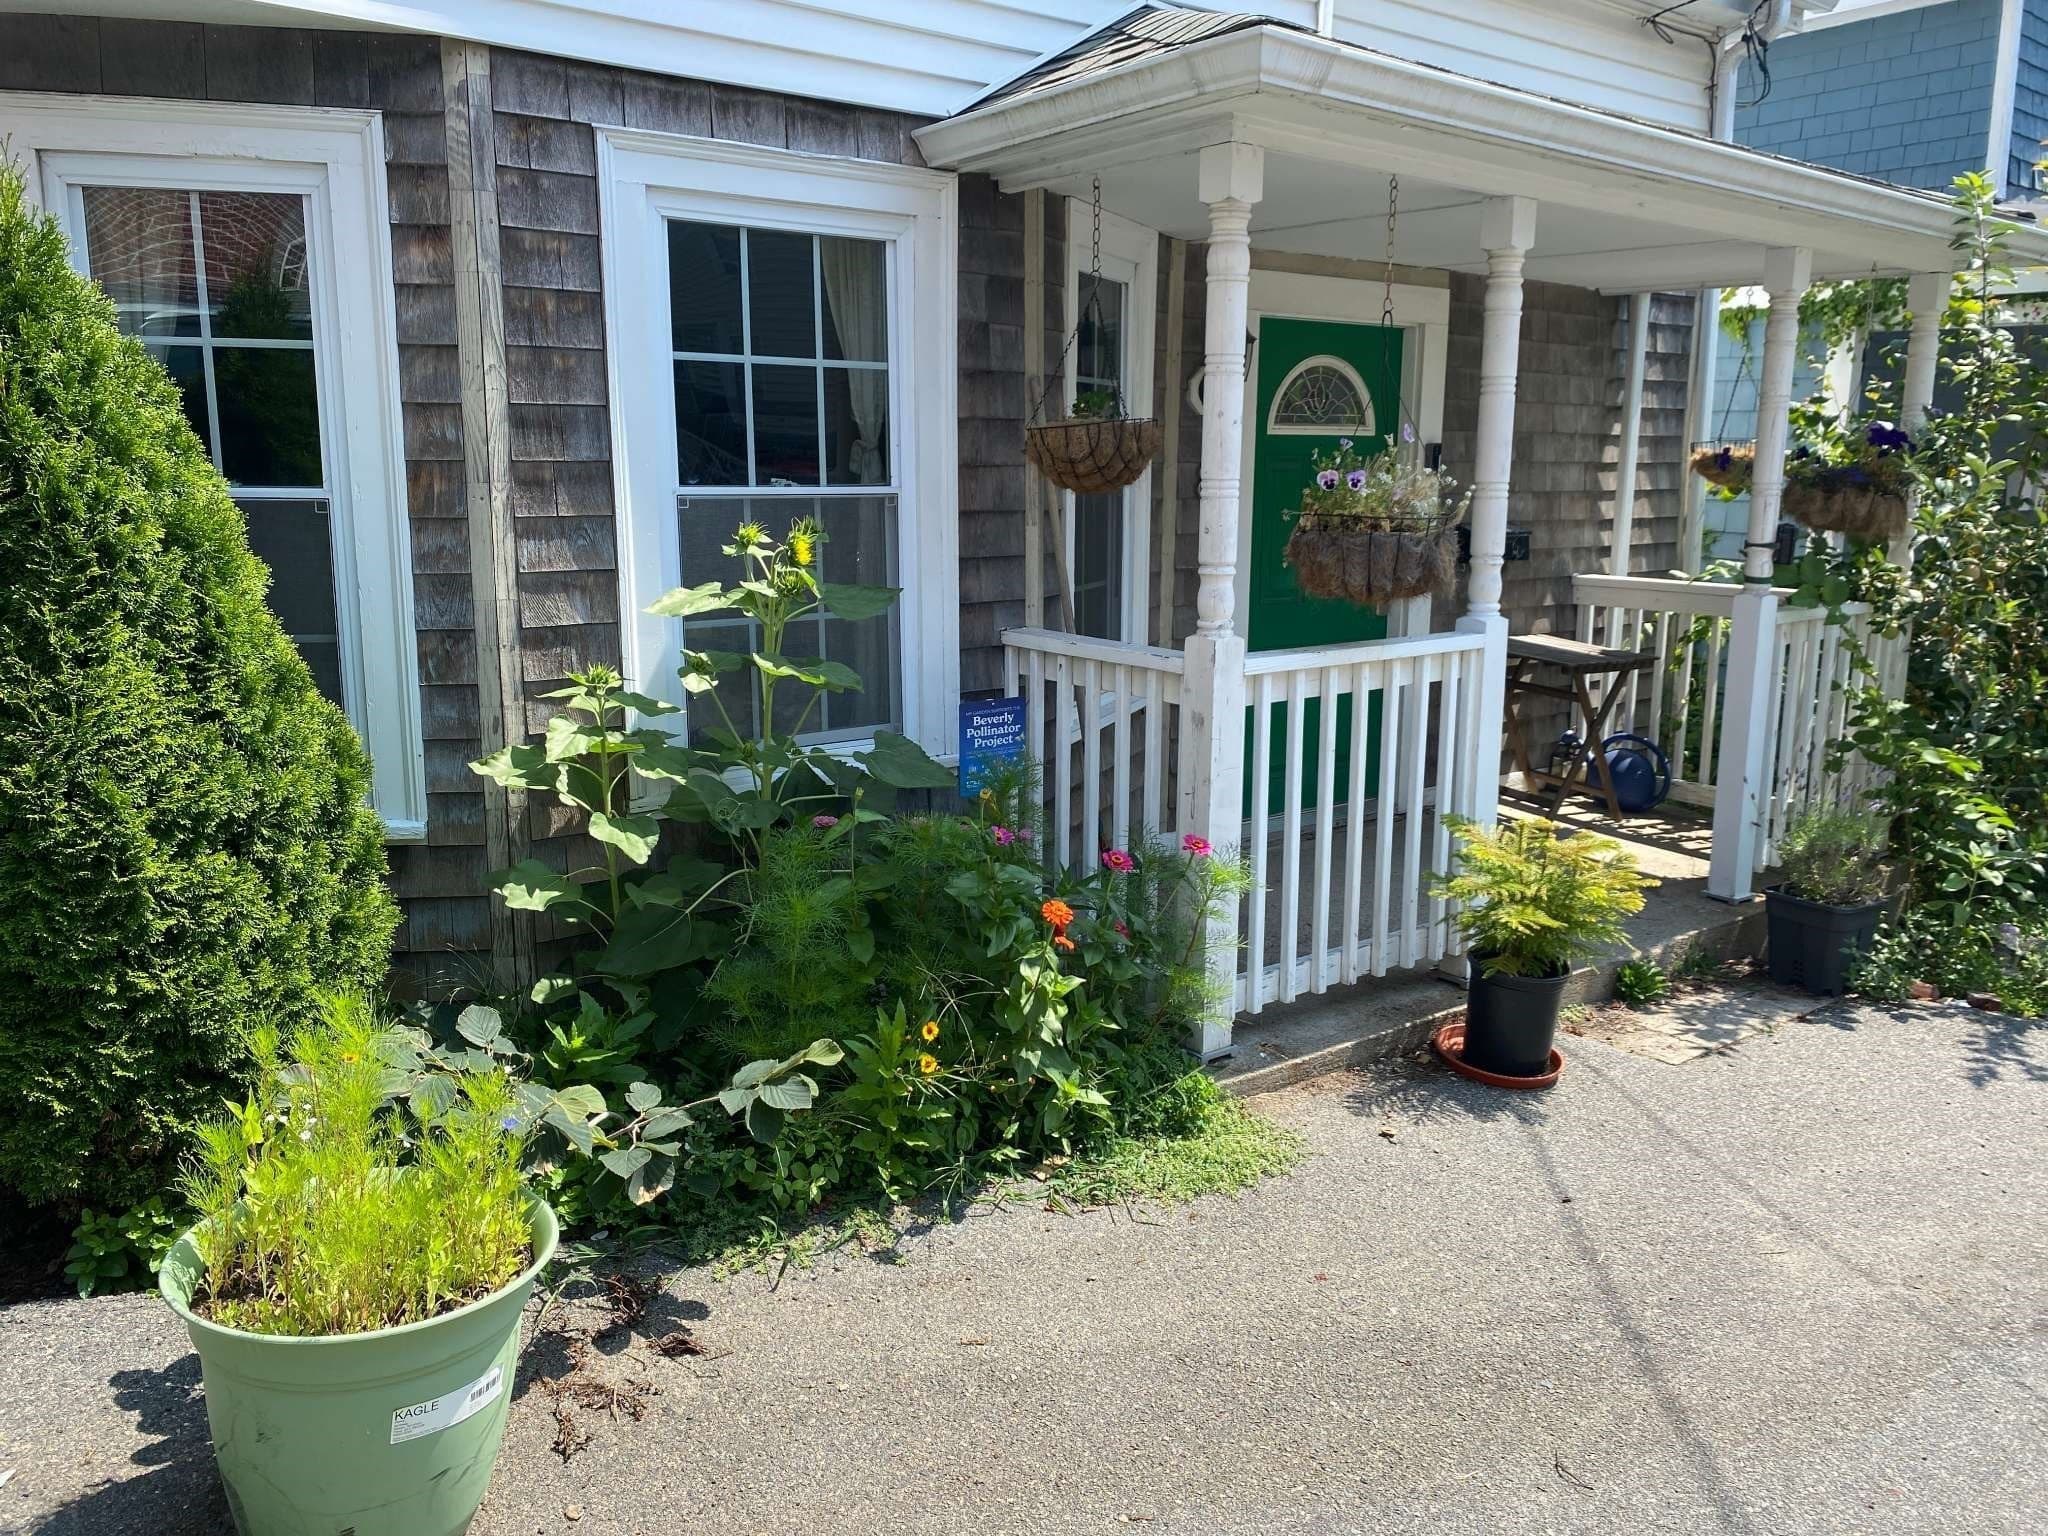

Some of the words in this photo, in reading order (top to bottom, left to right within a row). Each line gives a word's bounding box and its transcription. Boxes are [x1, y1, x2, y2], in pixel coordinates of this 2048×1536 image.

[973, 712, 1014, 726] Beverly
[966, 724, 1021, 738] Pollinator
[974, 735, 1014, 748] Project
[394, 1400, 439, 1421] KAGLE
